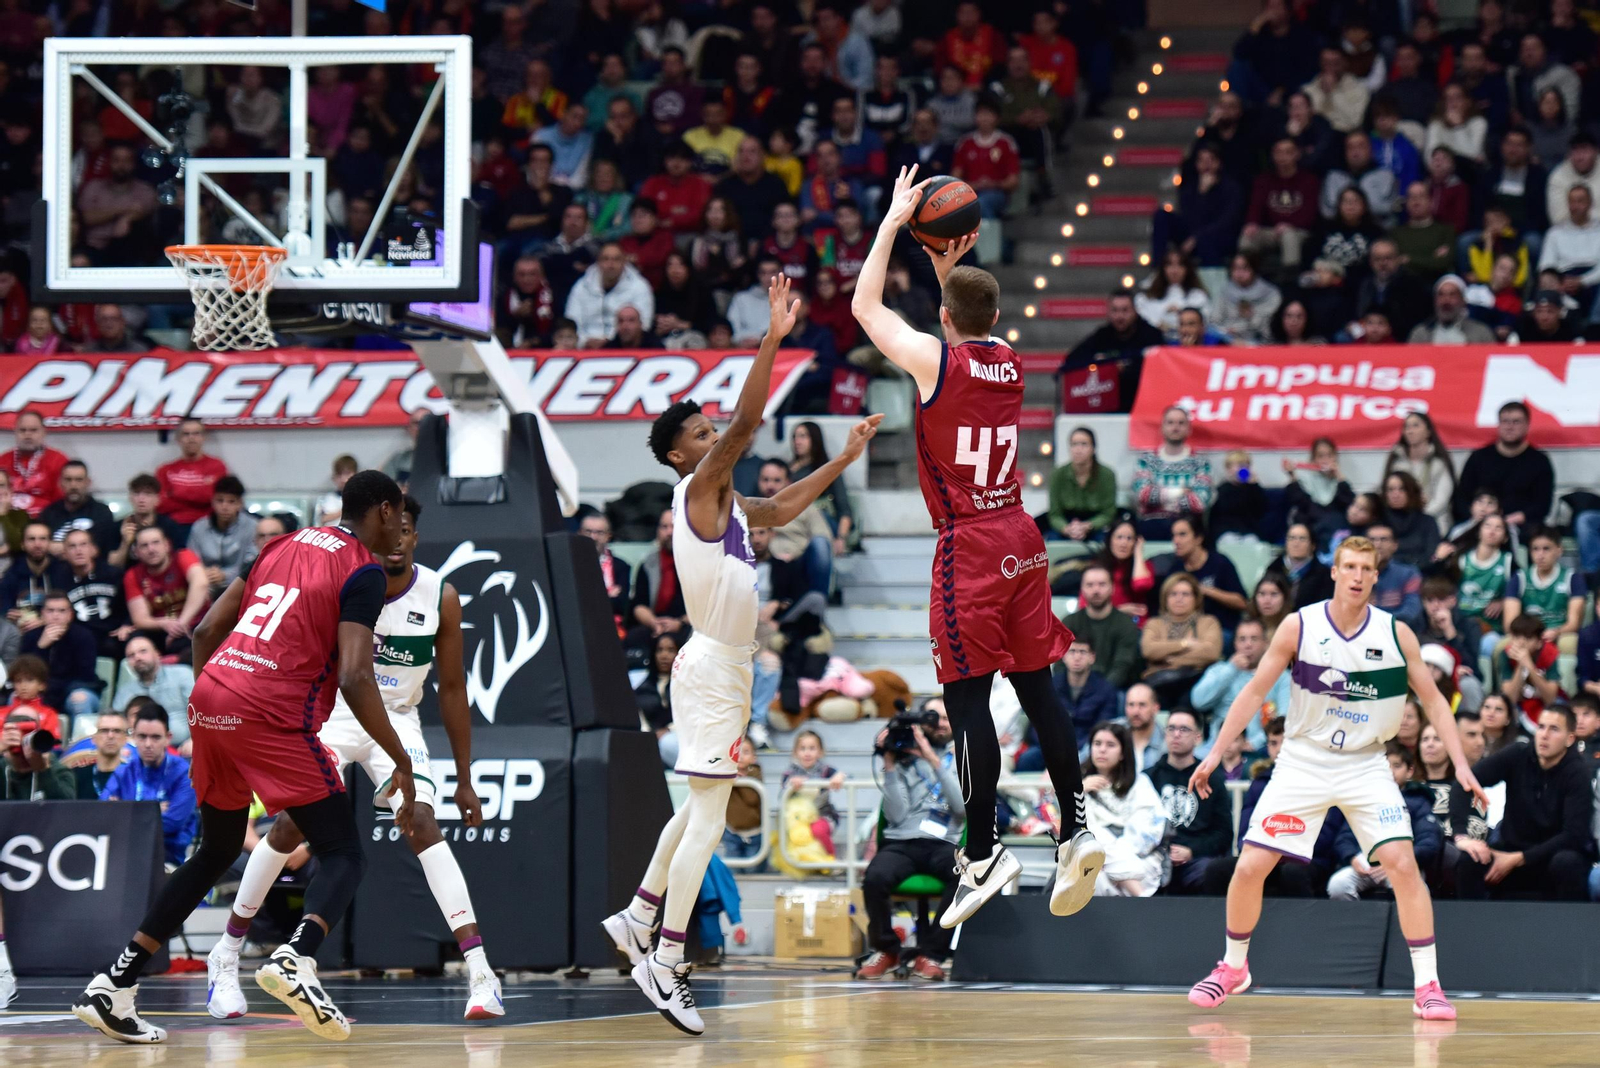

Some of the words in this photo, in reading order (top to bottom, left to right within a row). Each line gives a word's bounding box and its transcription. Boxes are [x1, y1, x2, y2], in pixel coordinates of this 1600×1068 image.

[1206, 358, 1436, 392] Impulsa
[954, 424, 1017, 487] 47
[233, 582, 300, 642] 21
[218, 656, 228, 666] de
[224, 646, 278, 671] Ayuntamiento
[376, 644, 414, 662] Unicaja
[215, 715, 242, 725] Cálida
[372, 826, 511, 843] SOIONS
